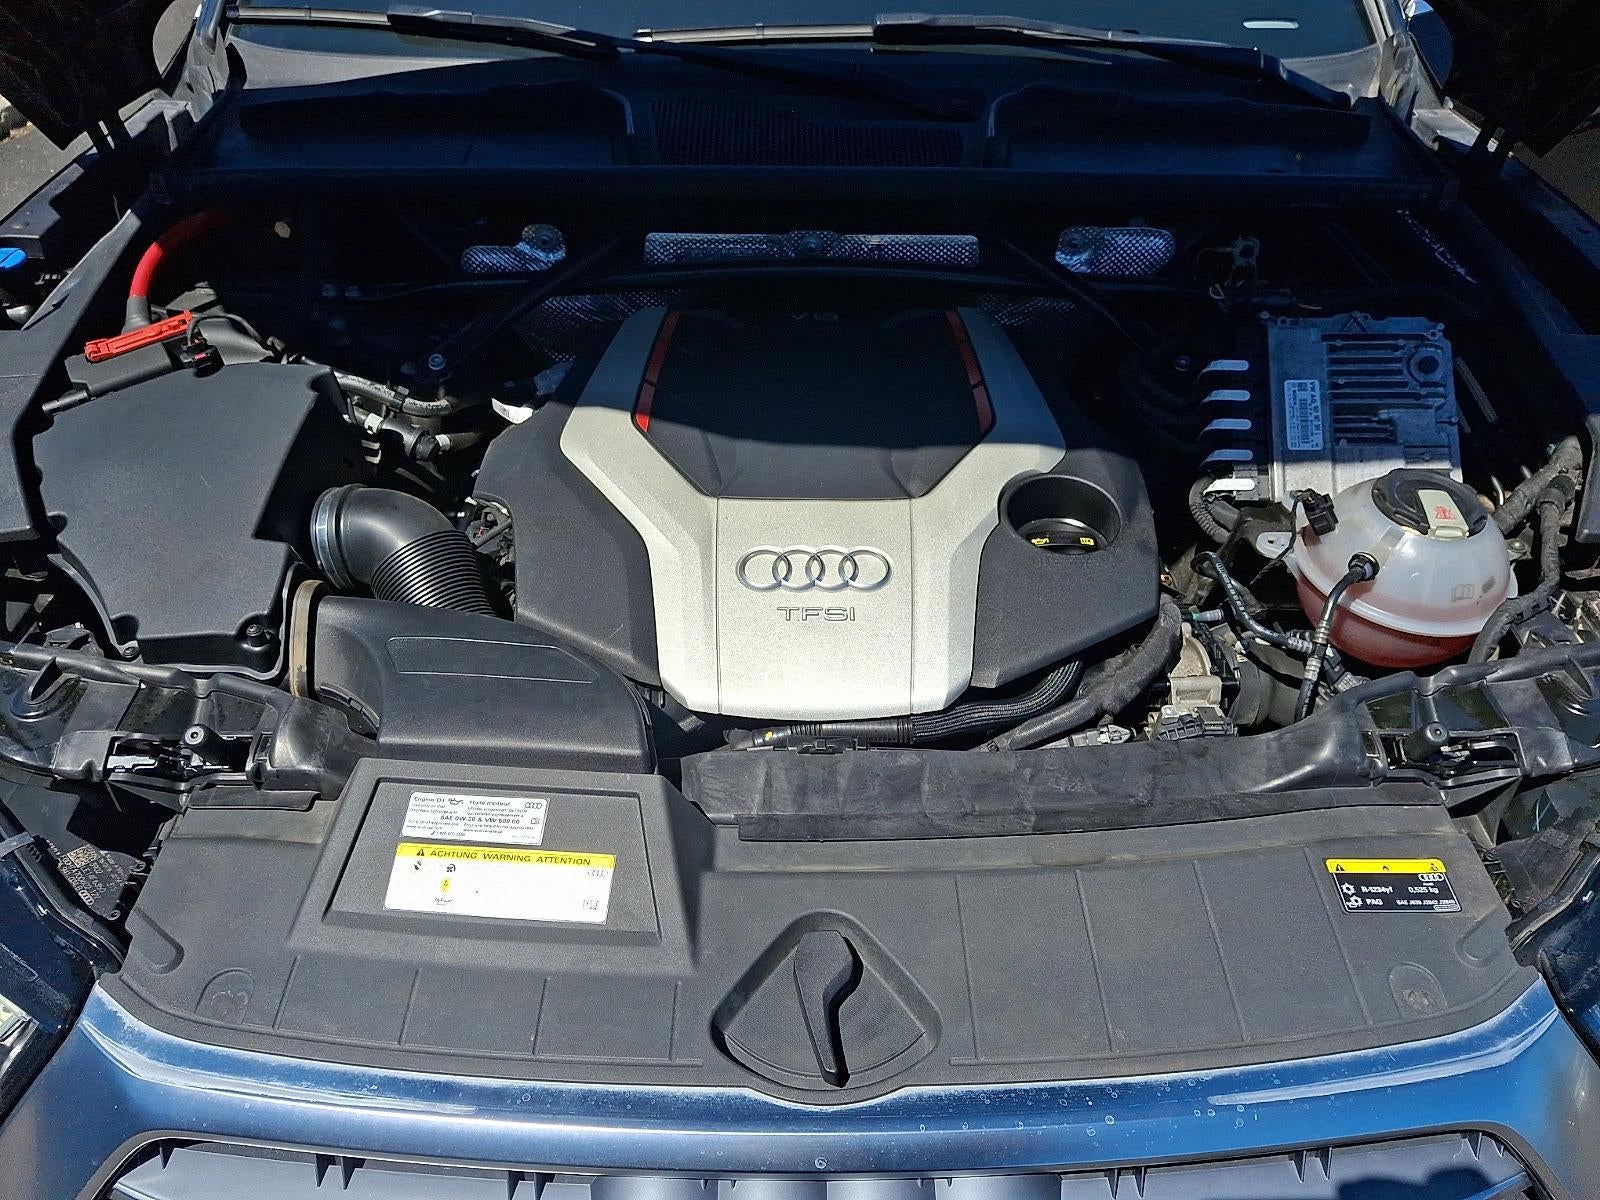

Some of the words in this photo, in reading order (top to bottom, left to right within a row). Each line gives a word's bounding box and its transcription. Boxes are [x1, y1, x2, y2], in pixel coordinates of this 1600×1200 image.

[777, 606, 856, 622] TFSI
[430, 850, 478, 860] ACHTUNG
[483, 852, 531, 863] WARNING
[536, 855, 591, 866] ATTENTION
[1408, 886, 1428, 894] 0,525
